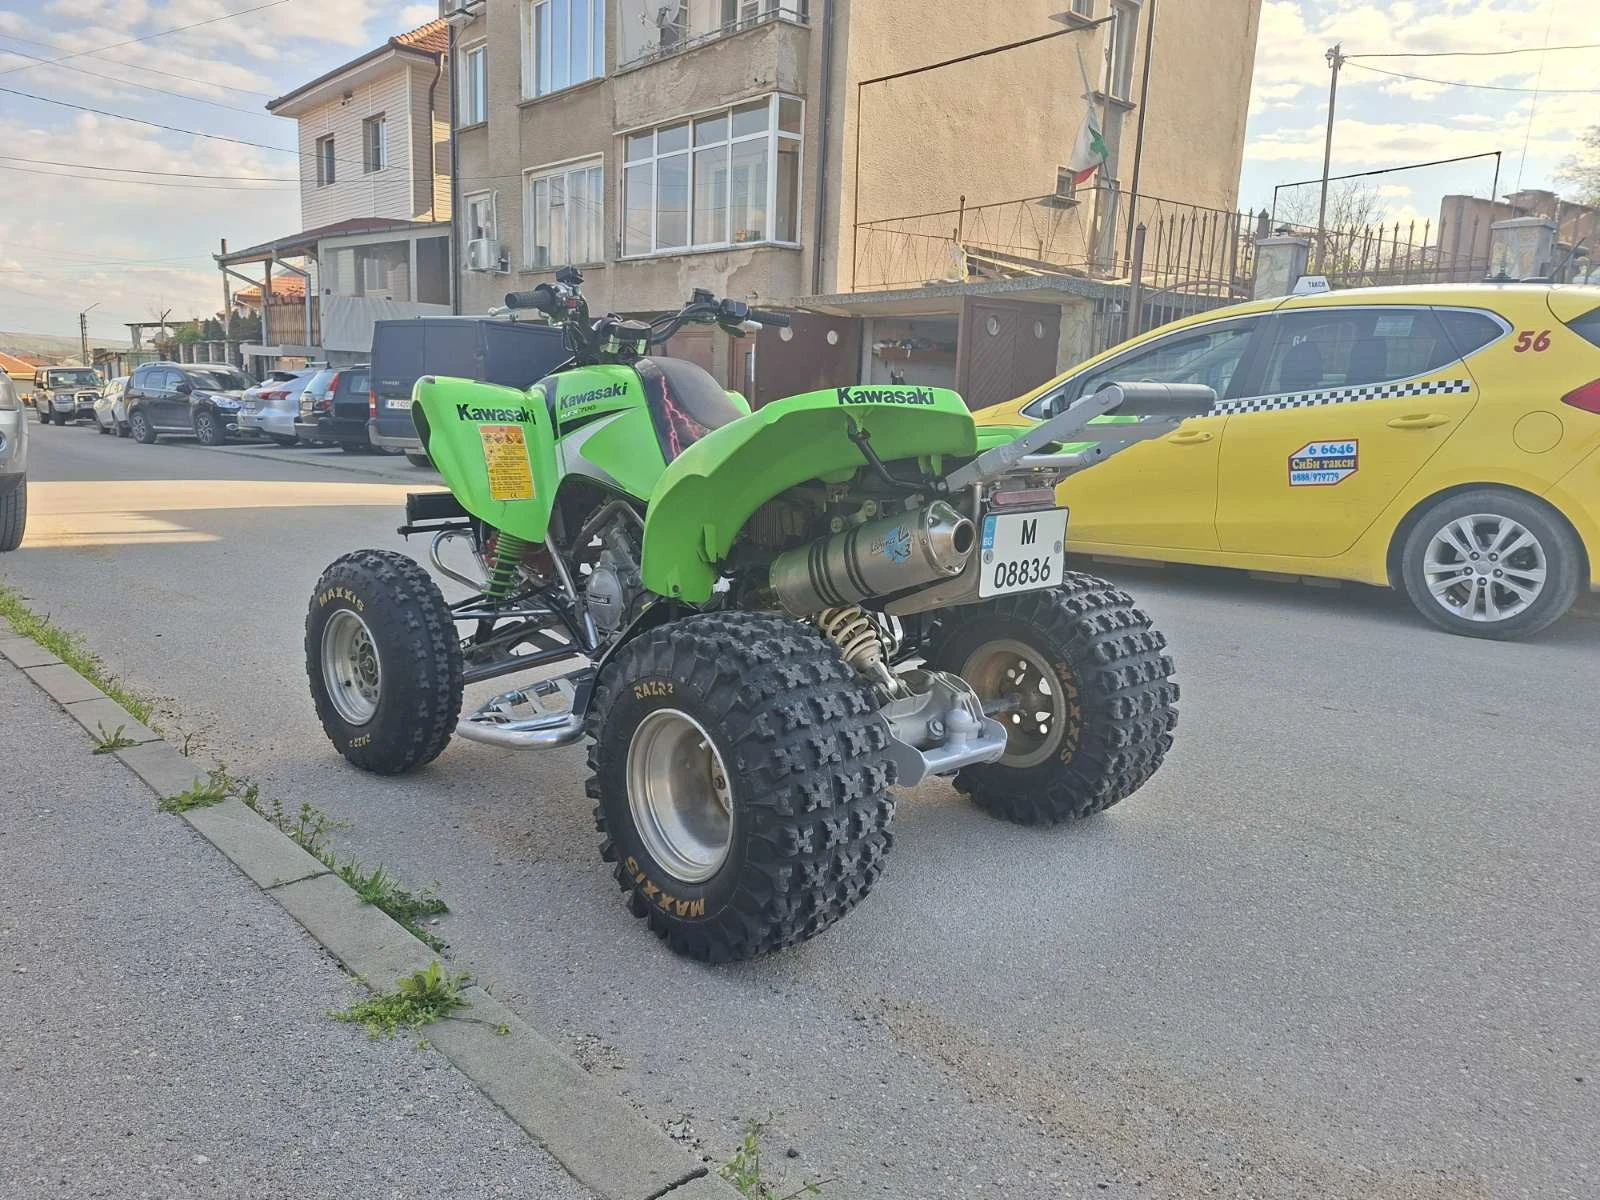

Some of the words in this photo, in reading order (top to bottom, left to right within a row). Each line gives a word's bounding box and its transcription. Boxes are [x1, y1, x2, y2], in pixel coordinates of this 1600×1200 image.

[1513, 330, 1552, 353] 56
[559, 382, 629, 411] Kawasaki
[837, 387, 935, 405] Kawasaki
[456, 403, 537, 425] Kawasaki
[1308, 446, 1317, 456] 6
[1321, 444, 1354, 455] 6646
[1322, 458, 1354, 468] такси
[982, 536, 993, 546] BG
[1020, 519, 1037, 545] M
[993, 556, 1051, 589] 08836
[319, 586, 365, 612] MAXXIS
[625, 855, 705, 917] MAXXIS
